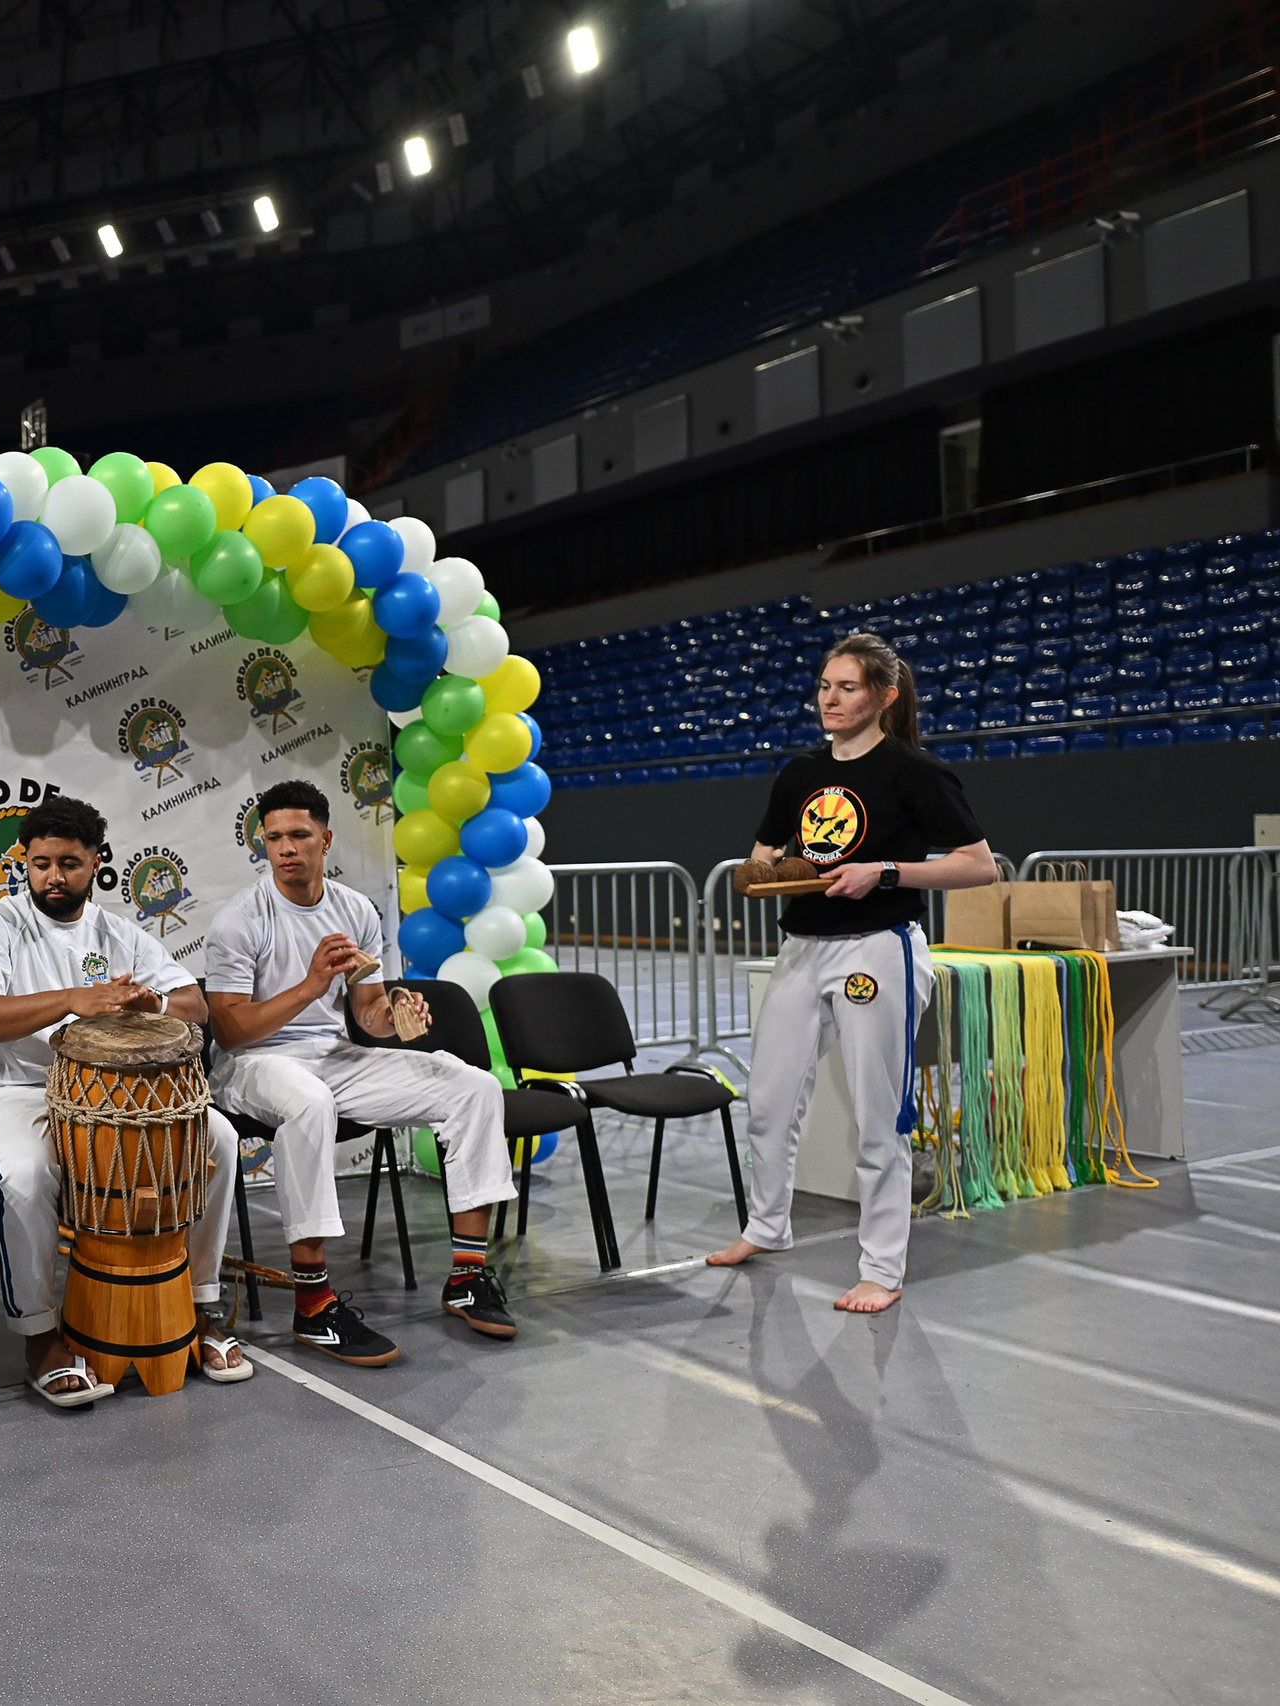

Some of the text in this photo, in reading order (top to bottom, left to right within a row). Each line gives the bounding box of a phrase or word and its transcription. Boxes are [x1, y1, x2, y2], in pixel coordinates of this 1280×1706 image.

[65, 665, 149, 709] КАЛИНИНГРАД
[236, 647, 297, 701] CORDÃO DE OURO
[118, 697, 186, 753] CORDÃO DE OURO
[260, 723, 333, 764] КАЛИНИНГРАД
[359, 741, 373, 751] DE
[141, 776, 221, 822] КАЛИНИНГРАД
[823, 787, 845, 796] REAL
[235, 797, 255, 847] CORDÃO
[121, 853, 142, 904] CORDÃO
[143, 846, 158, 857] DE
[161, 847, 188, 875] OURO
